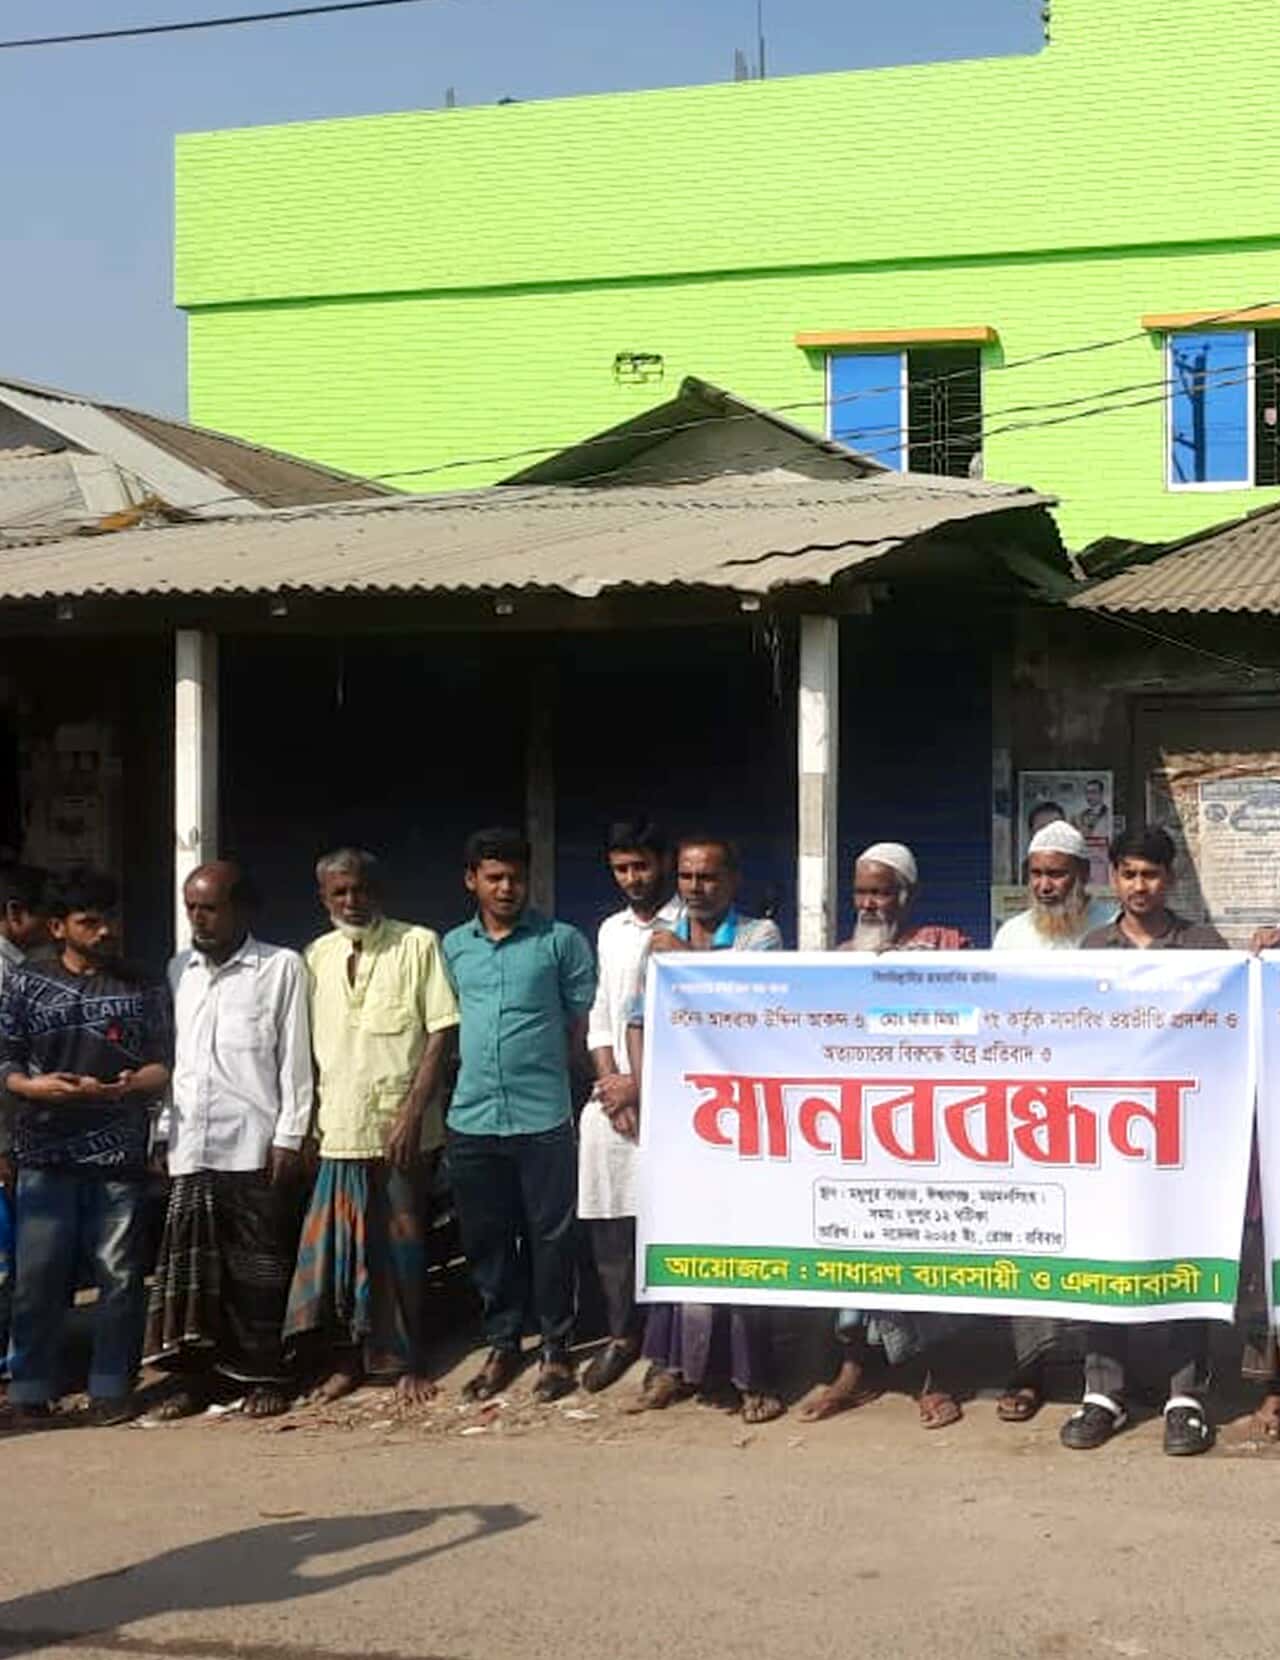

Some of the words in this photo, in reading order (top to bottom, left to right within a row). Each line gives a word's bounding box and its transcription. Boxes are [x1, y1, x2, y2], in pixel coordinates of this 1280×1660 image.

[684, 1073, 1200, 1170] মানববন্ধন
[664, 1256, 790, 1281] আয়োজনে
[816, 1260, 904, 1285] সাধারণ
[909, 1260, 1019, 1290] ব্যাবসায়ী
[1030, 1271, 1052, 1290] ও
[1060, 1263, 1202, 1298] এলাকাবাসী
